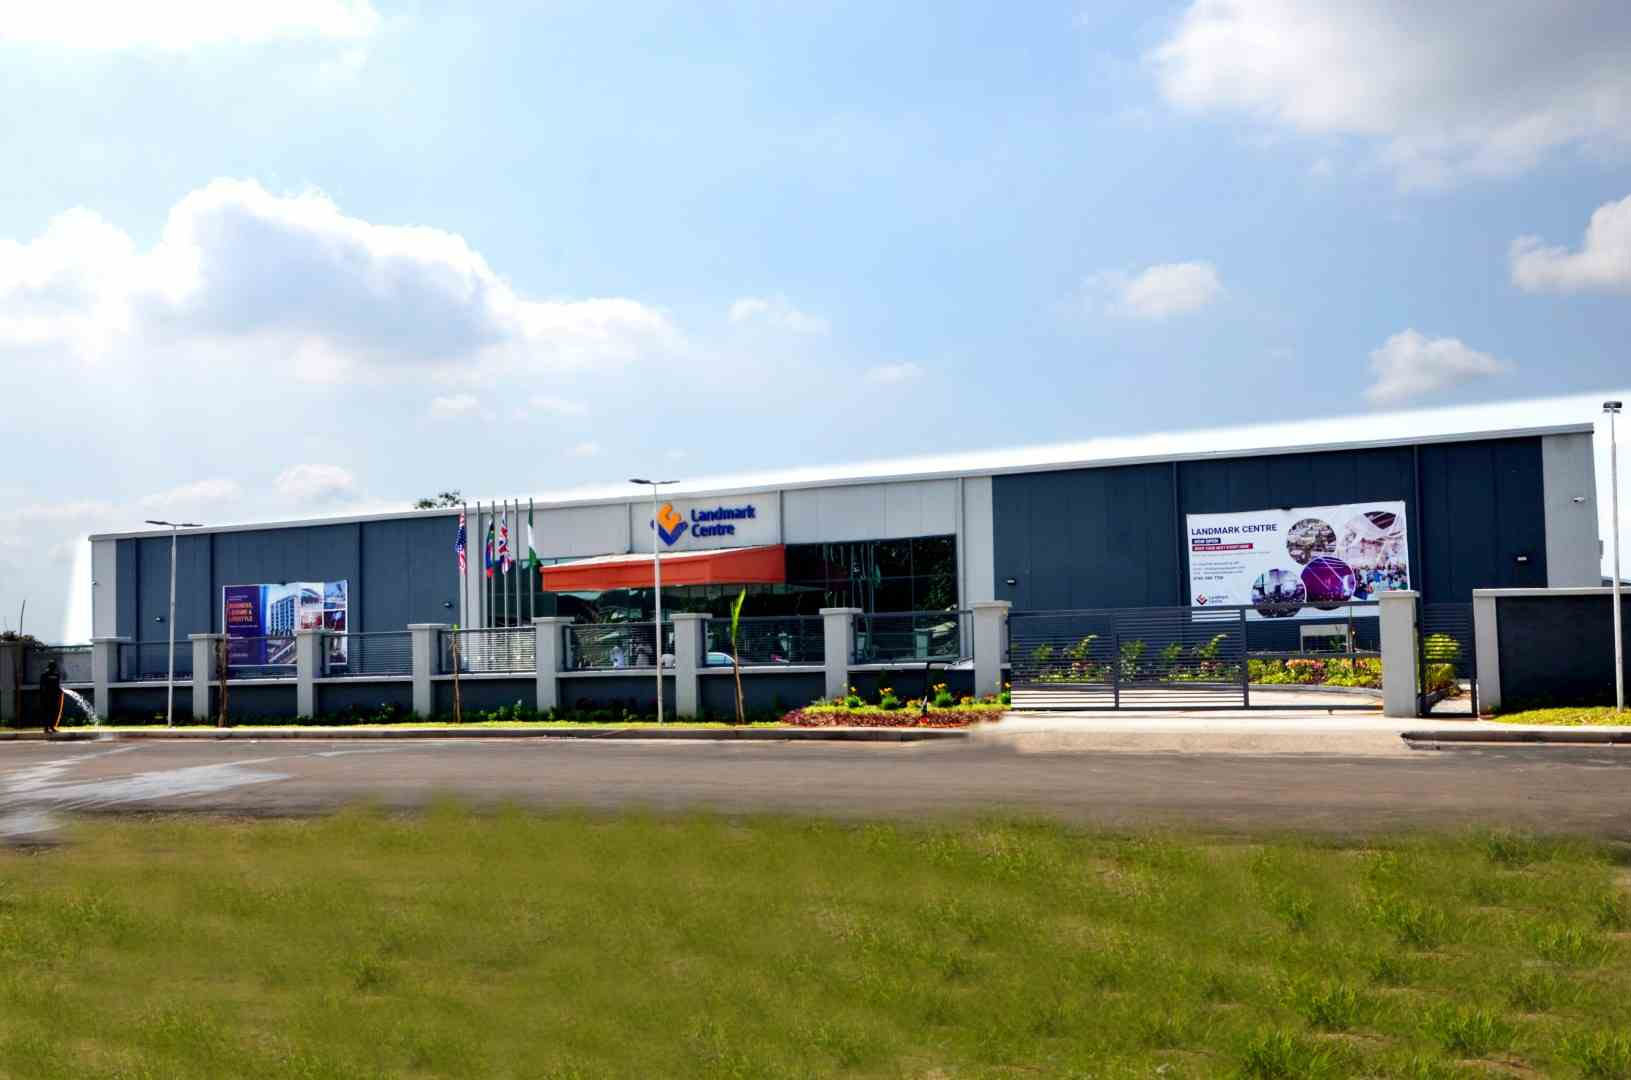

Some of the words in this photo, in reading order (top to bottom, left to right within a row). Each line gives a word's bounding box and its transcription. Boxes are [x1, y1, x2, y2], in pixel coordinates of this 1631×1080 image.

[691, 505, 756, 522] Landmark
[691, 524, 735, 538] Centre
[1191, 526, 1240, 536] LANDMARK
[1242, 523, 1278, 533] CENTRE
